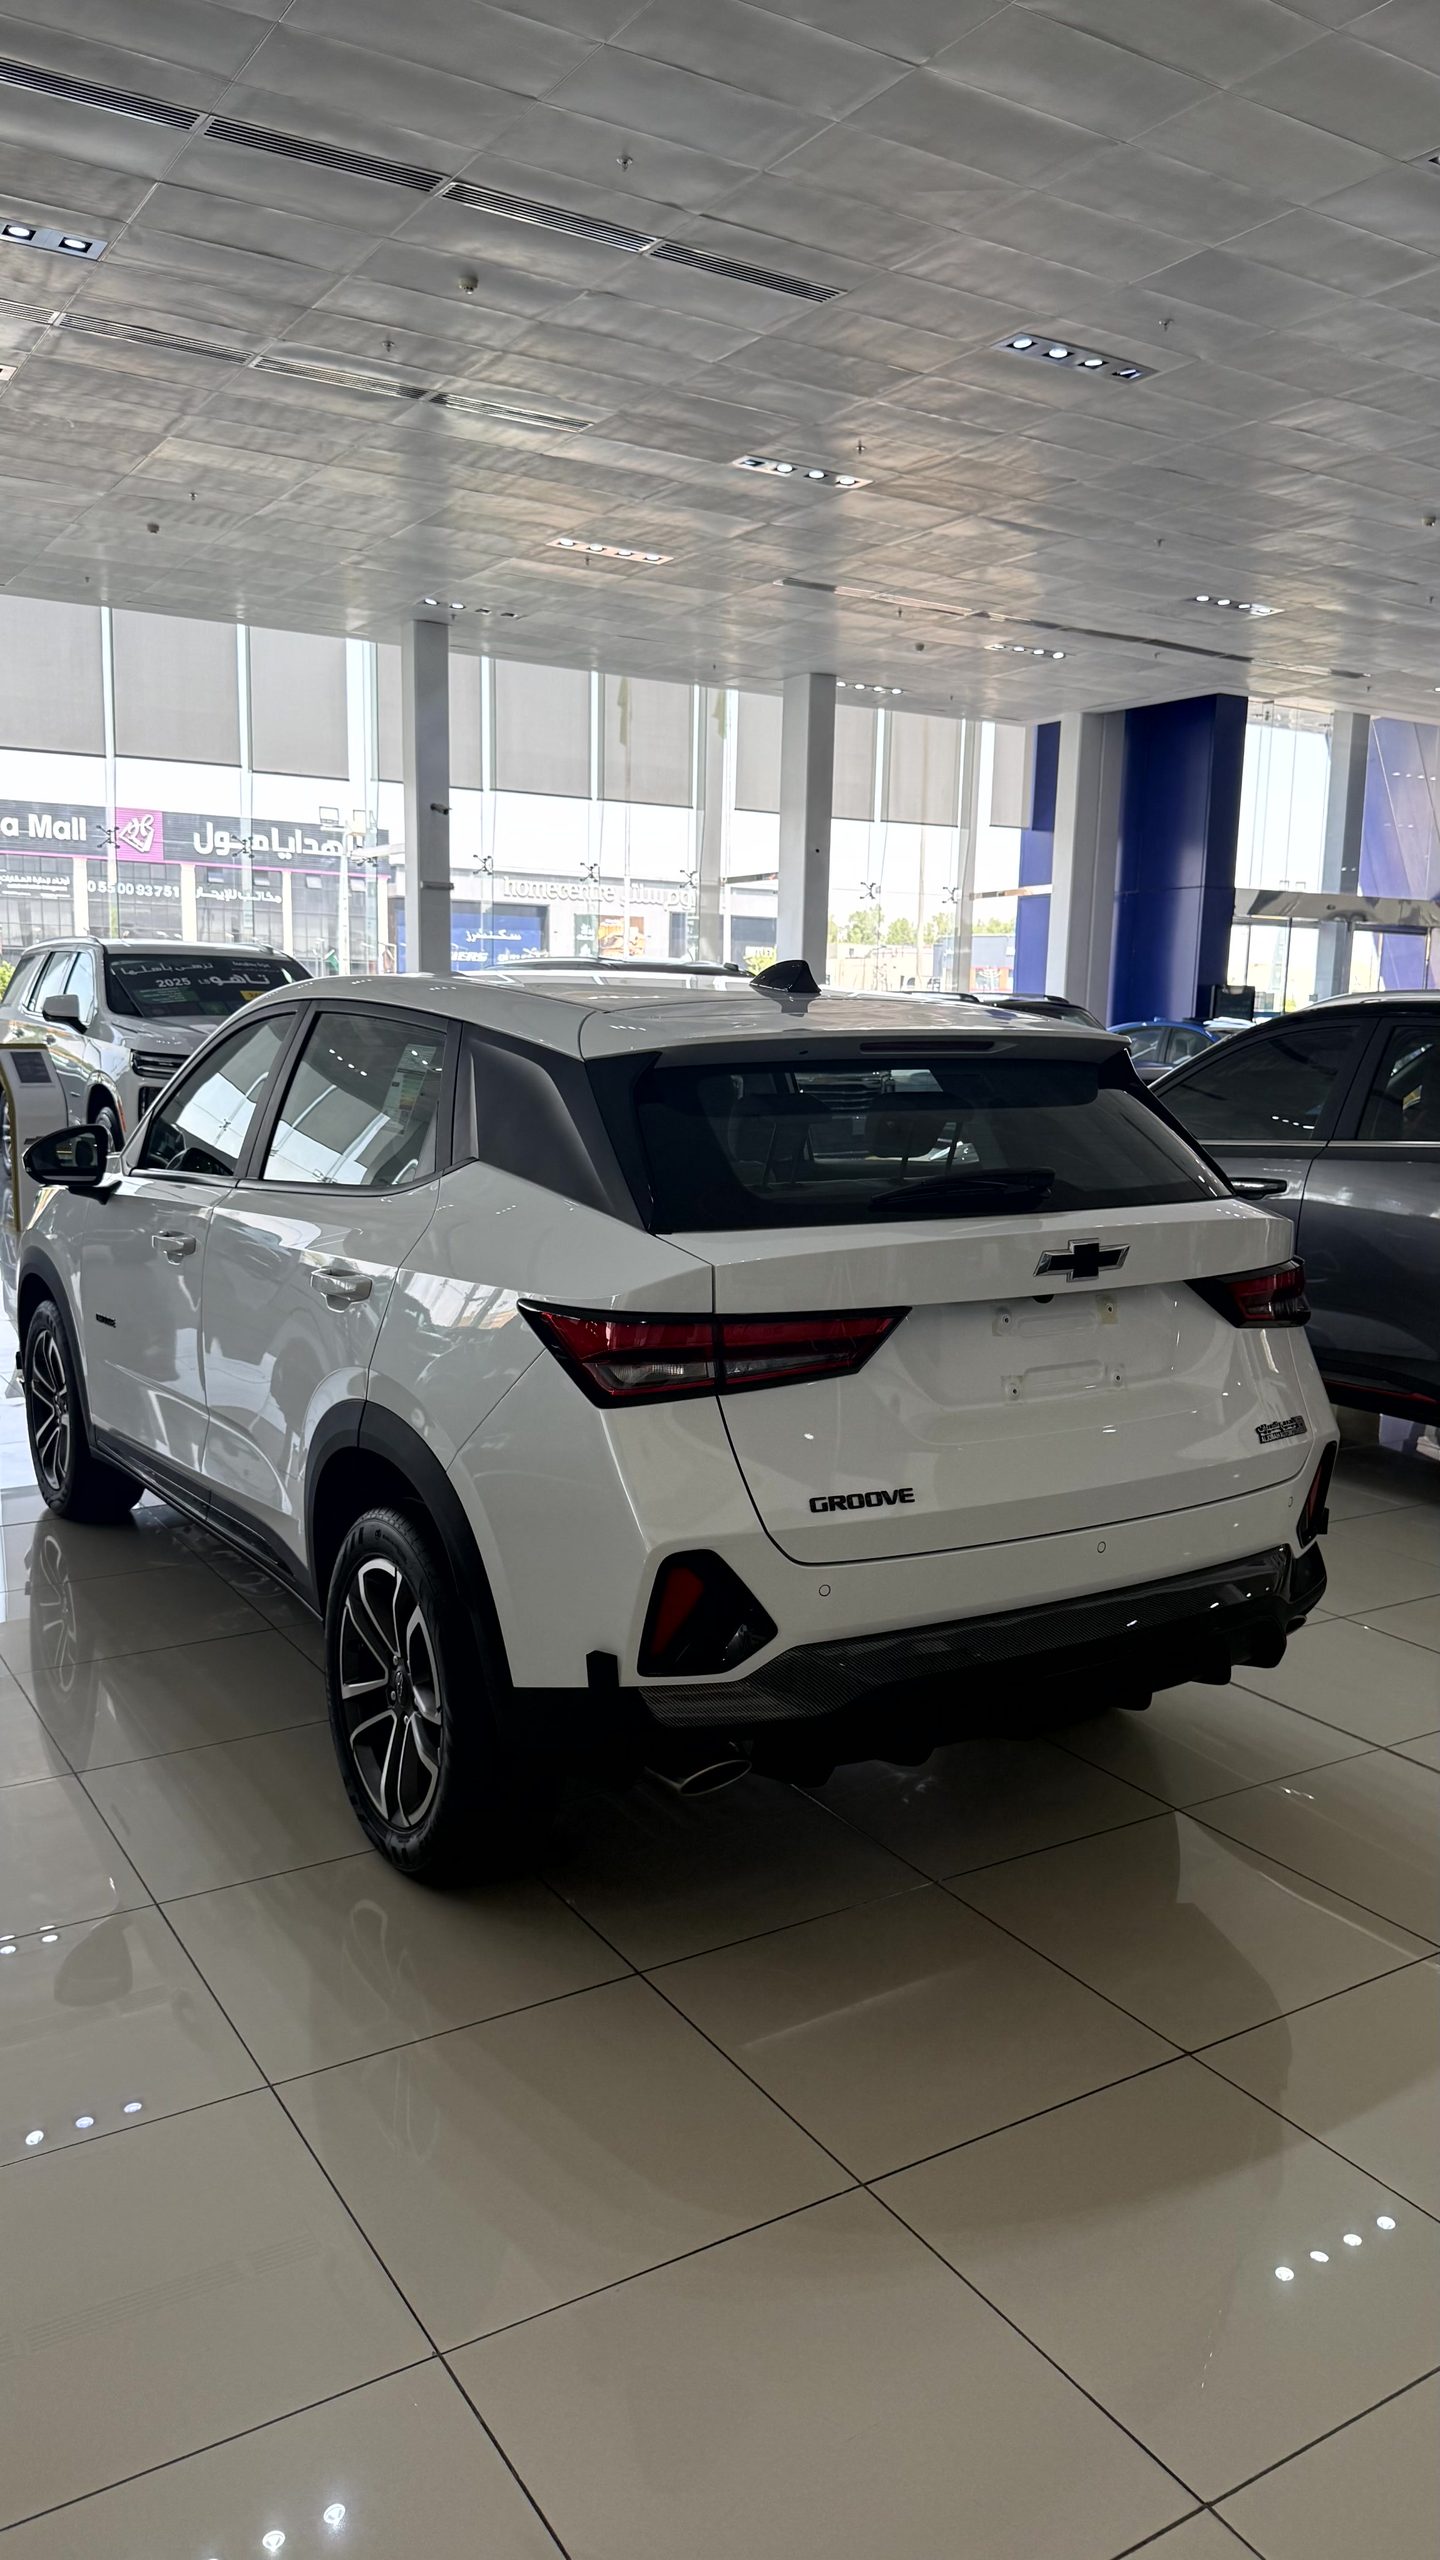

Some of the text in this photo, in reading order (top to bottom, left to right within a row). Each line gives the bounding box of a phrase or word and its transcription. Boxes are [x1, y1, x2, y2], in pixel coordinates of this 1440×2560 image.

[28, 813, 87, 841] Mall
[193, 821, 270, 856] مول
[503, 875, 616, 902] homecentre
[155, 977, 192, 988] 2025
[809, 1487, 916, 1513] GROOVE
